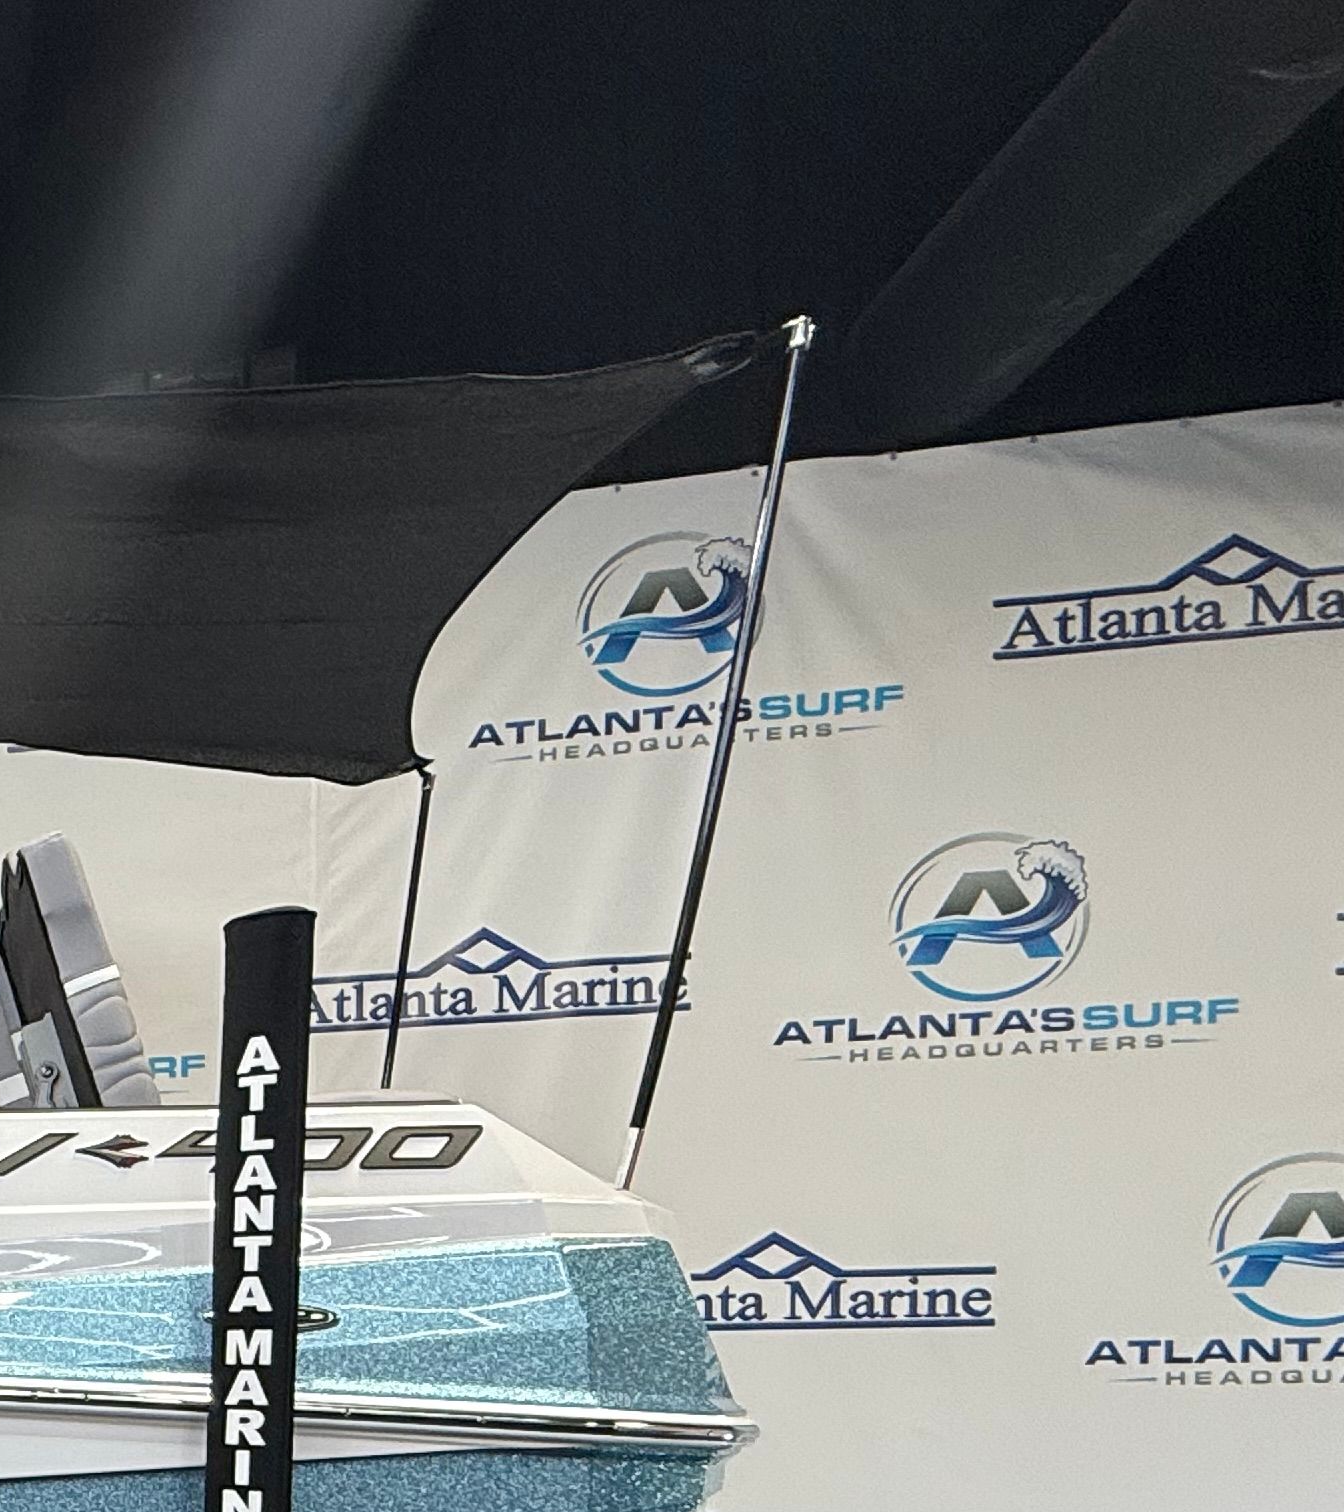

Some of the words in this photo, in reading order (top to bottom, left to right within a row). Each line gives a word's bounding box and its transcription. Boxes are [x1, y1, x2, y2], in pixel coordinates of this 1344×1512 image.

[1000, 598, 1226, 649] Atlanta
[539, 722, 833, 762] HEADQUATERS
[848, 1033, 1165, 1063] HEADQUARTERS
[228, 1034, 281, 1314] ATLANTA
[783, 1276, 993, 1321] Marine
